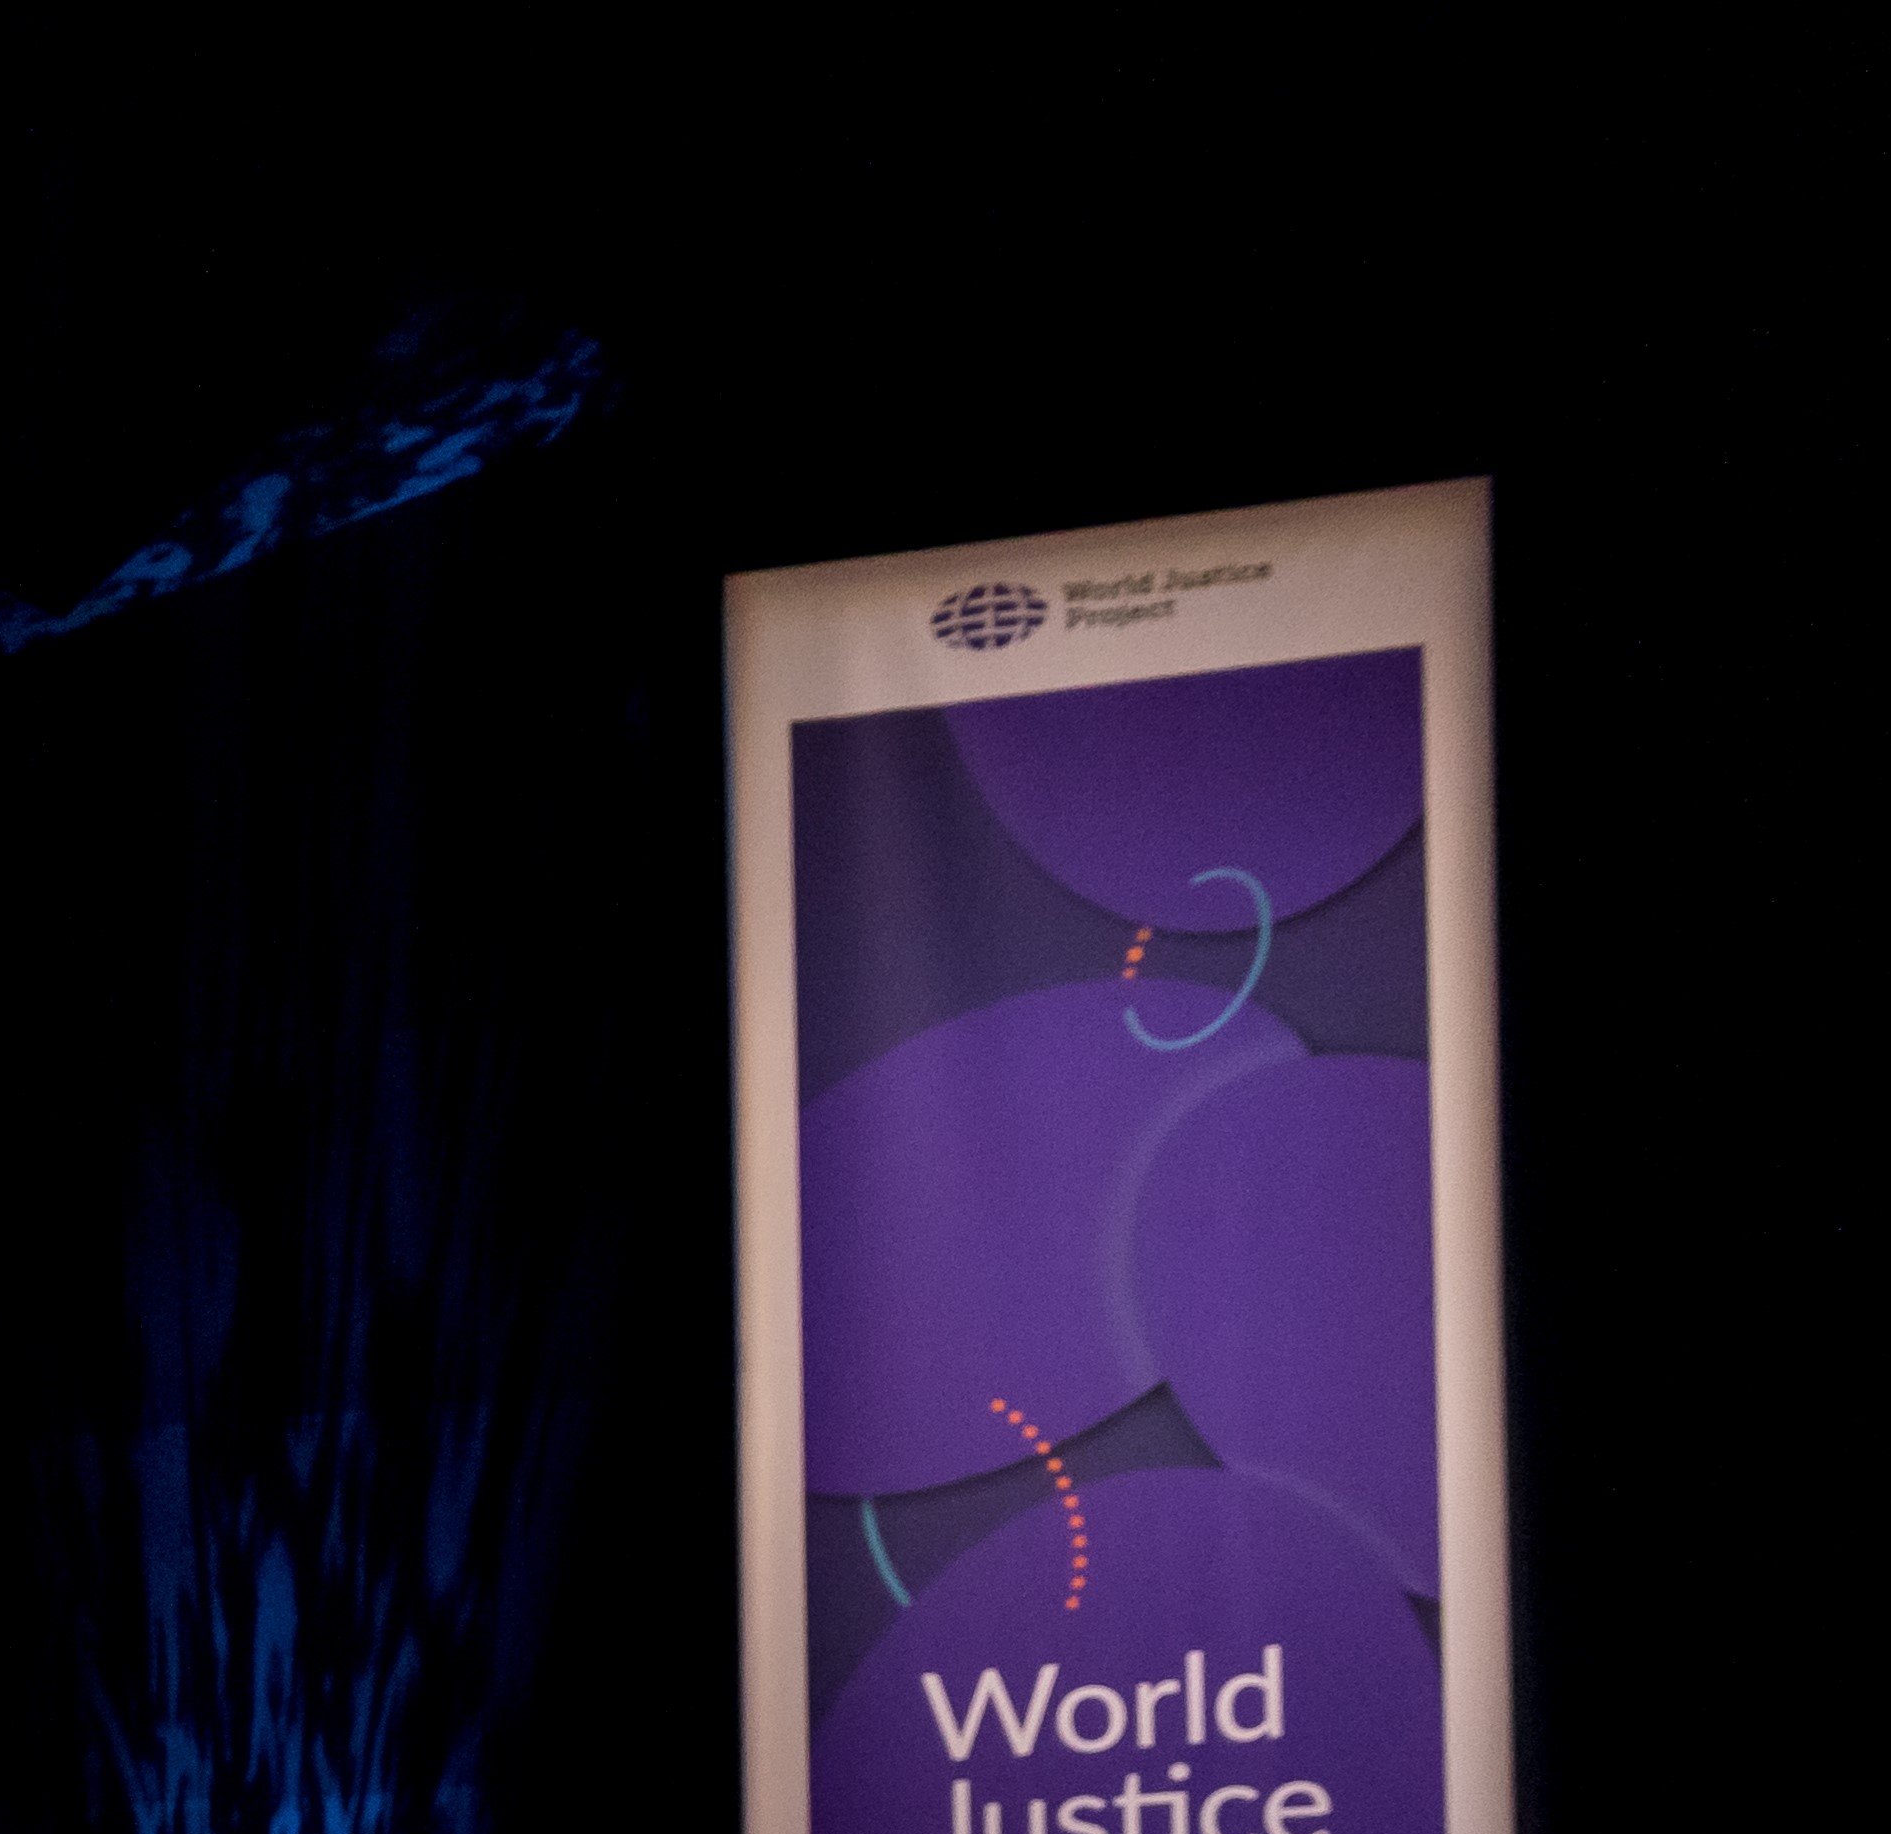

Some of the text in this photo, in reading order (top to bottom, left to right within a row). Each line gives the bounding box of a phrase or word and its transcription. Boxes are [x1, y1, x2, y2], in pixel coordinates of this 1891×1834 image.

[1064, 561, 1271, 600] World Justice
[1066, 601, 1175, 628] Project
[921, 1643, 1285, 1762] World
